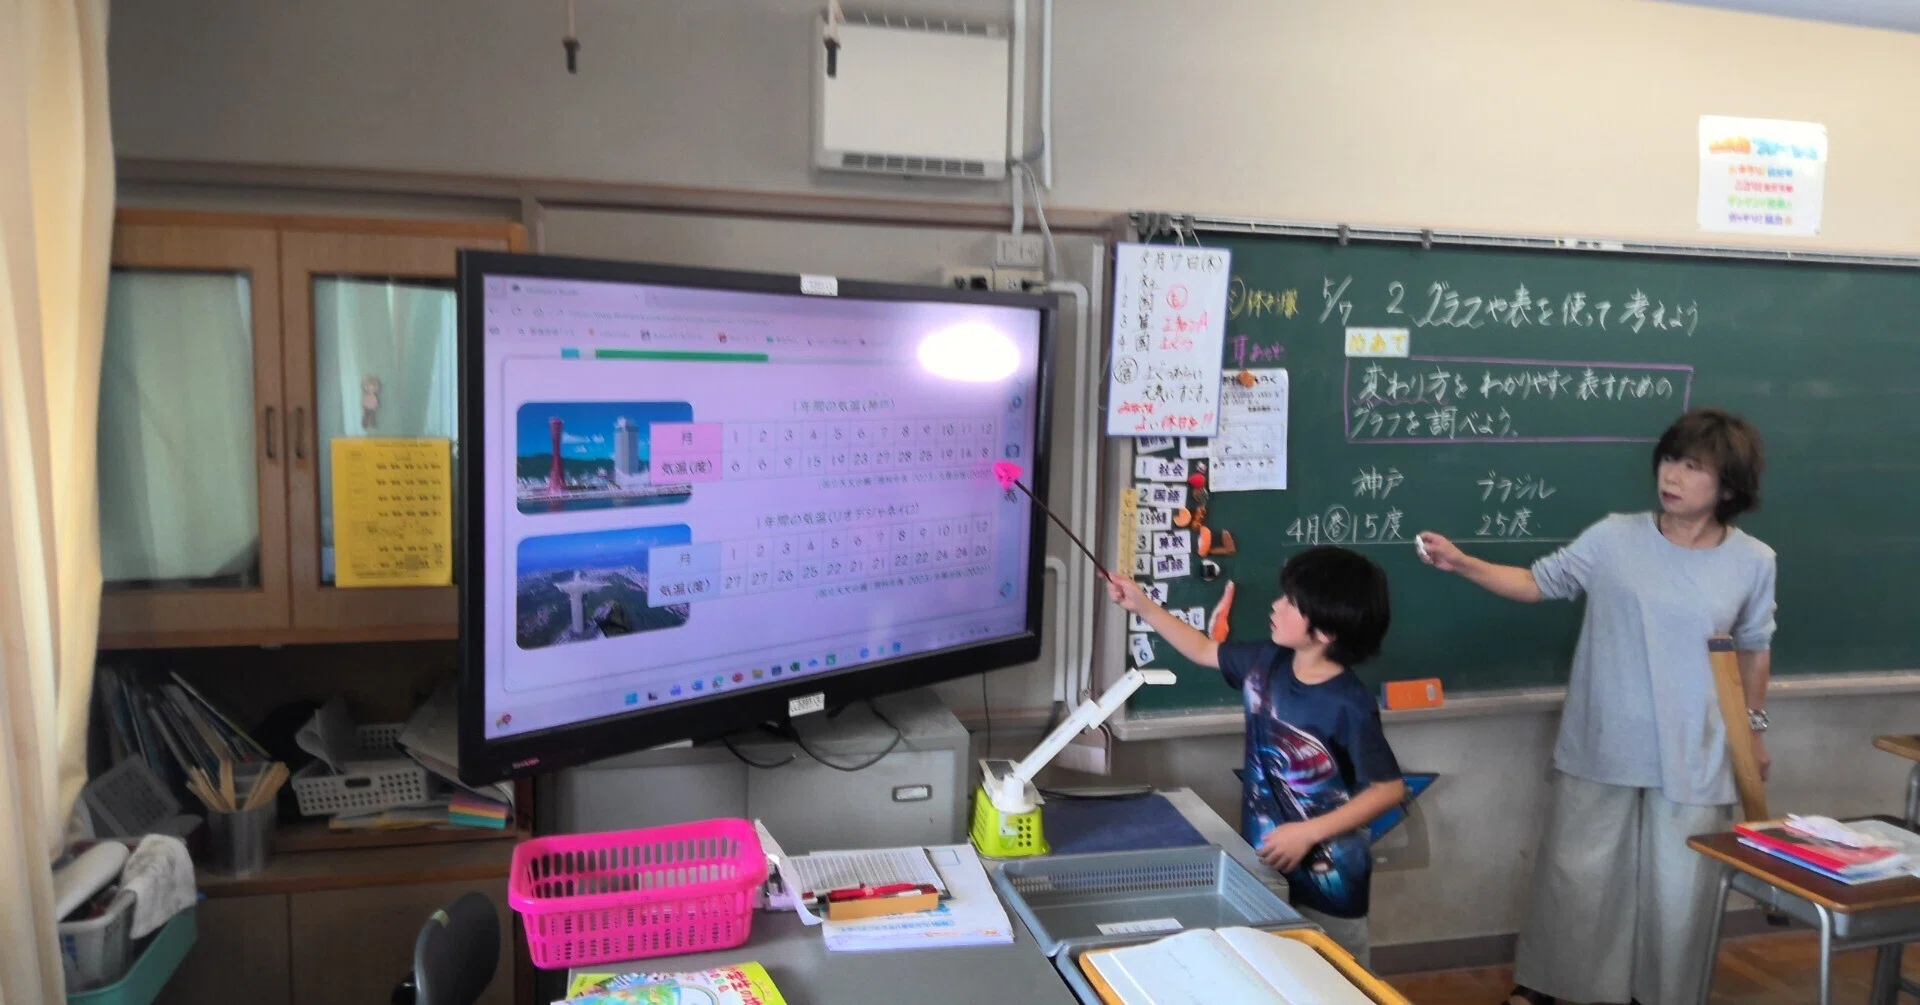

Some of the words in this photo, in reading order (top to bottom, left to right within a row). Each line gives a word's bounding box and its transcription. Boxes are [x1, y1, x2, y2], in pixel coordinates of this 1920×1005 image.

[1386, 281, 1405, 315] 2
[1347, 331, 1405, 354] めあて
[682, 431, 693, 445] 月
[1159, 463, 1184, 476] 社会
[1354, 466, 1404, 500] 神戸
[1476, 470, 1556, 500] ブラジル
[1139, 488, 1148, 502] 2
[1154, 489, 1180, 502] 国語
[1476, 507, 1534, 538] 25度
[1138, 536, 1146, 550] 3
[680, 553, 691, 567] 月
[1137, 558, 1144, 571] 4
[1140, 649, 1148, 661] 6
